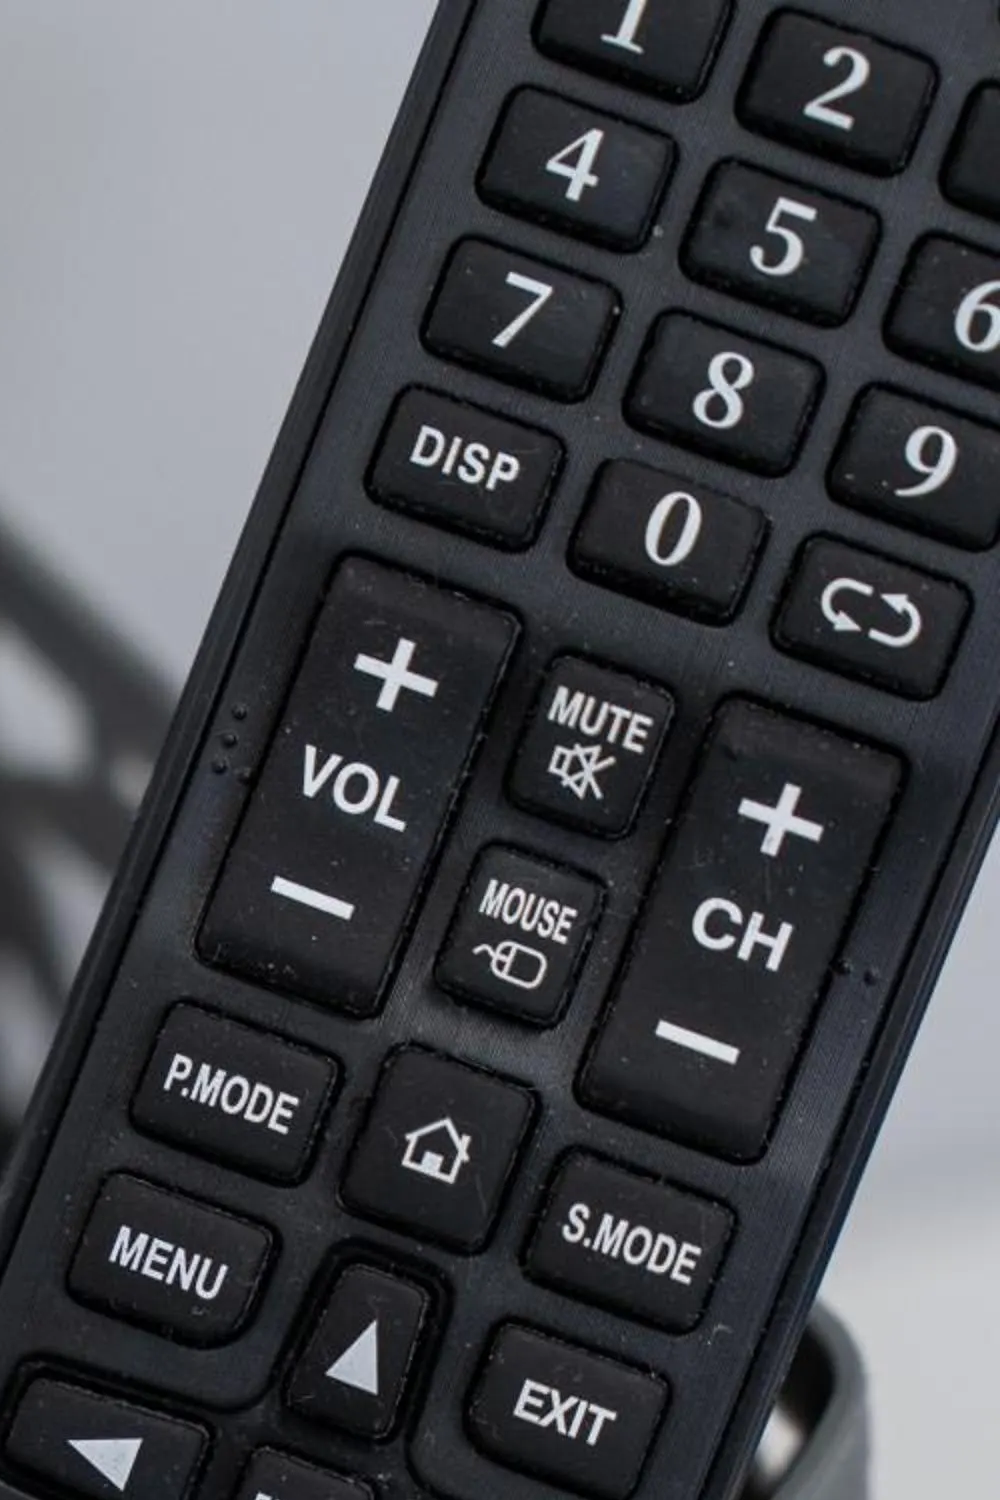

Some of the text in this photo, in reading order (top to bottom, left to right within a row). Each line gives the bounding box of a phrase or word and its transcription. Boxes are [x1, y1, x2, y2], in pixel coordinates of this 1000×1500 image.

[600, 0, 645, 54] 1
[803, 46, 870, 130] 2
[546, 128, 604, 201] 4
[749, 197, 817, 276] 5
[492, 271, 553, 347] 7
[954, 280, 1000, 352] 6
[693, 351, 754, 429] 8
[410, 425, 520, 490] DISP
[895, 425, 958, 497] 9
[645, 491, 702, 566] 0
[547, 686, 654, 753] MUTE
[302, 745, 406, 832] VOL
[478, 878, 578, 945] MOUSE
[692, 897, 793, 972] CH
[163, 1053, 300, 1135] P.MODE
[109, 1225, 229, 1300] MENU
[562, 1203, 702, 1285] S.MODE
[513, 1378, 617, 1446] EXIT
